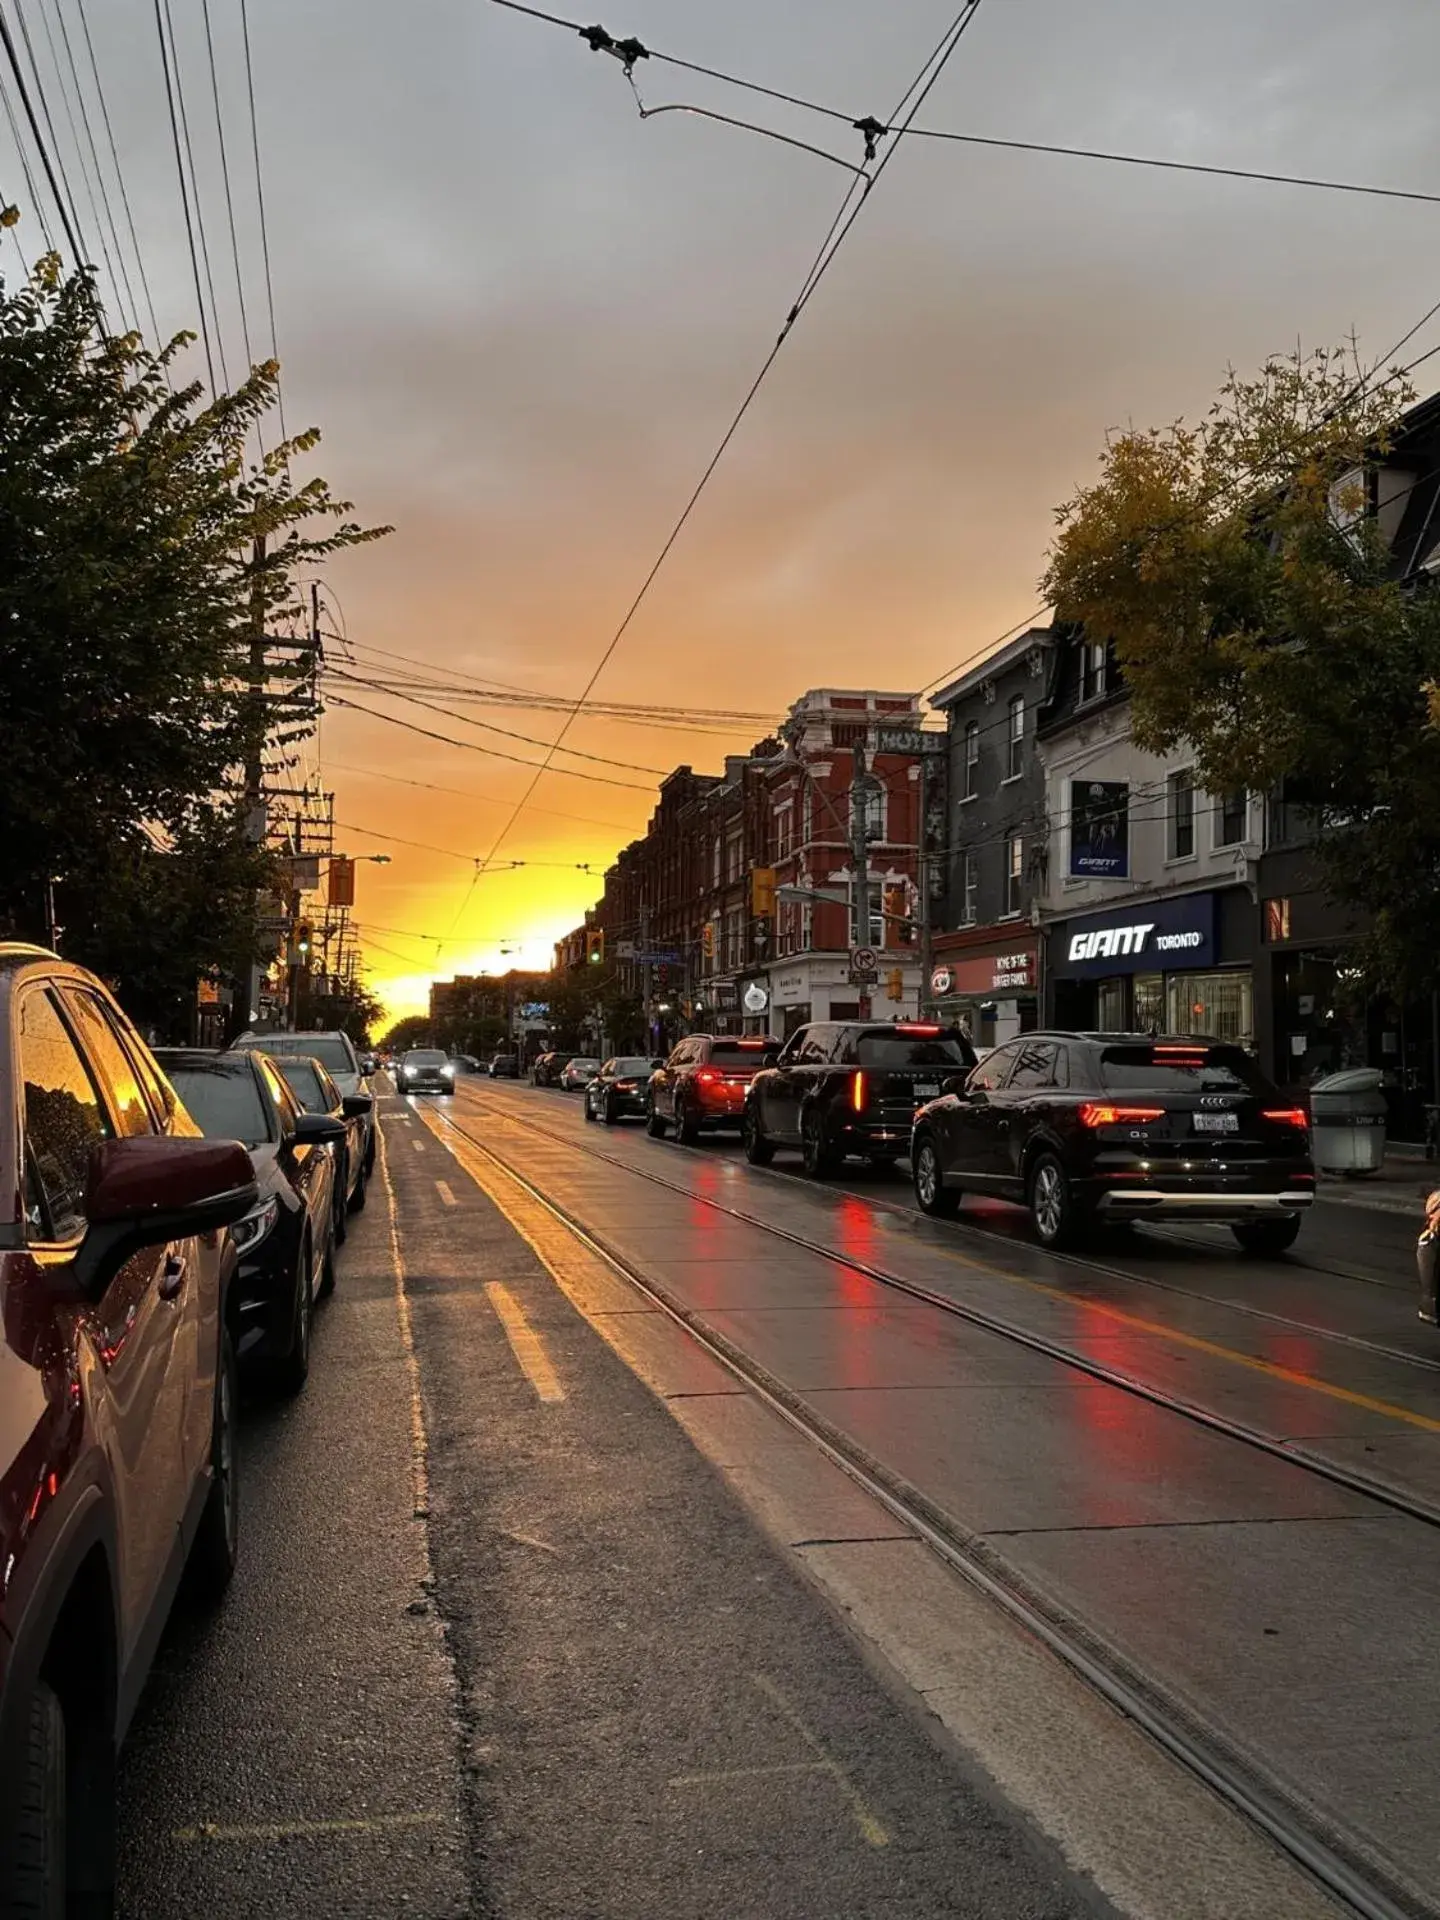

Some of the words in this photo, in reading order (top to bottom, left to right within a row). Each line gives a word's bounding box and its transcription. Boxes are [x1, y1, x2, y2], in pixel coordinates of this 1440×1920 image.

[1078, 857, 1120, 867] GIANT
[1068, 923, 1155, 961] GIANT
[1156, 931, 1200, 950] TORONTO
